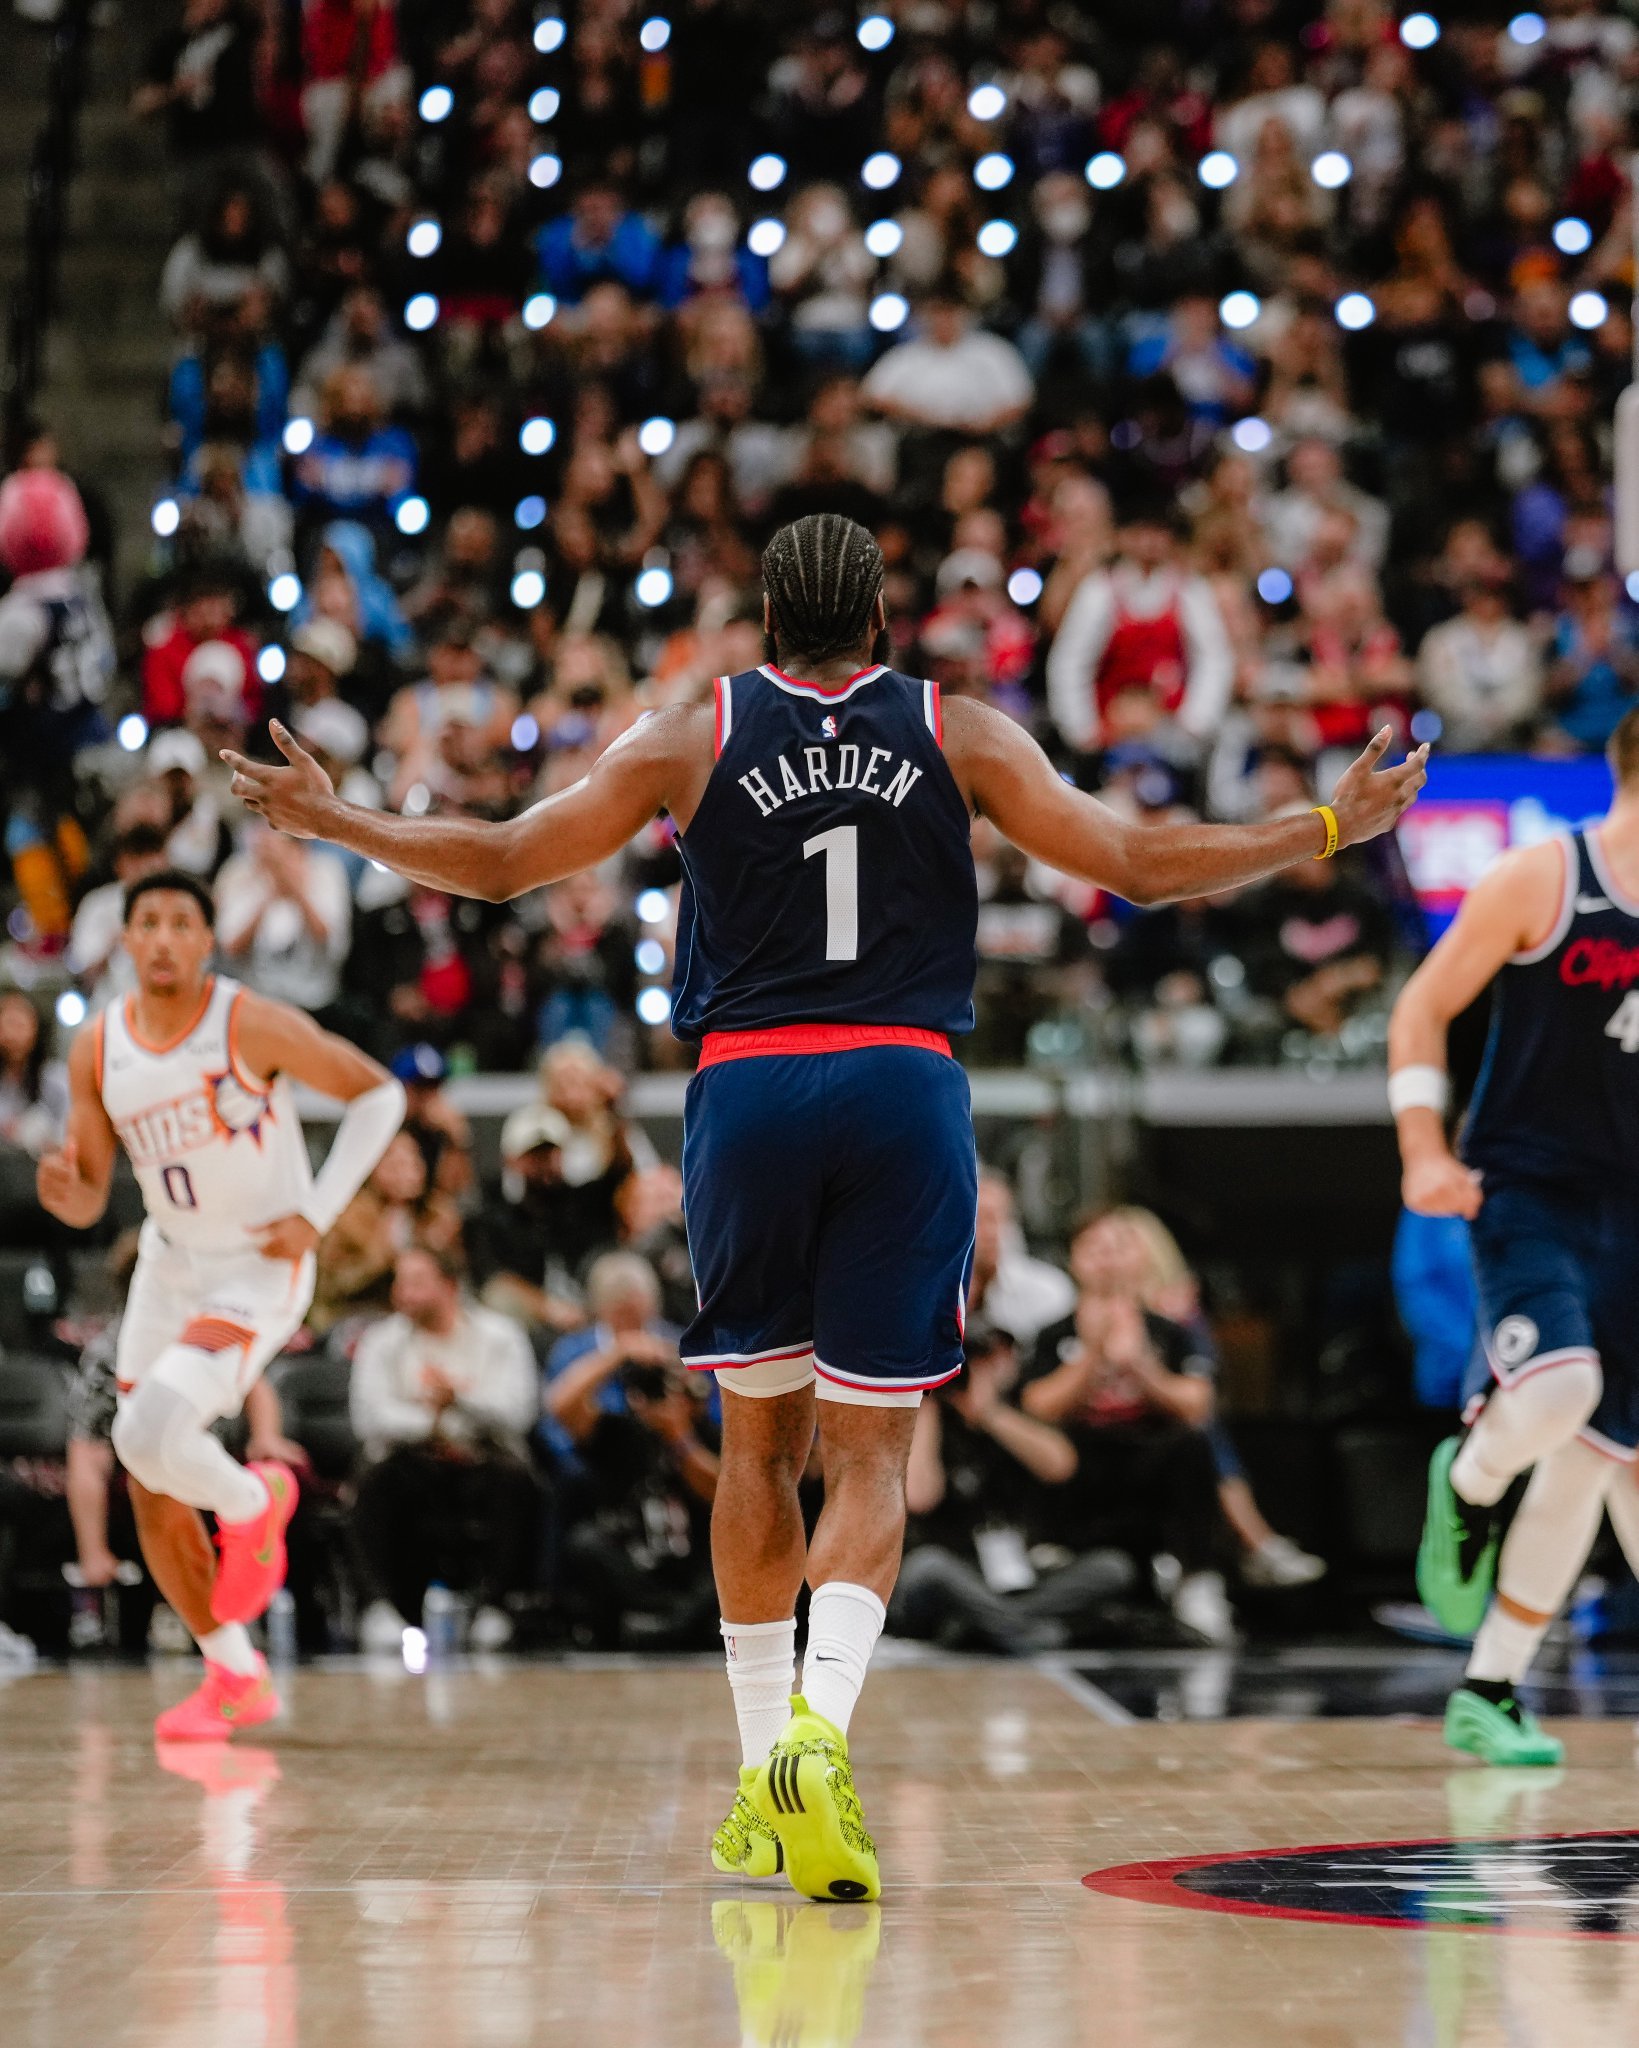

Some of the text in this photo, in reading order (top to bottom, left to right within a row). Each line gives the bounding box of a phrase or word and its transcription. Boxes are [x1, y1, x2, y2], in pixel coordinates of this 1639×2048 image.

[738, 744, 923, 817] HARDEN
[803, 825, 858, 961] 1
[162, 1164, 198, 1208] 0
